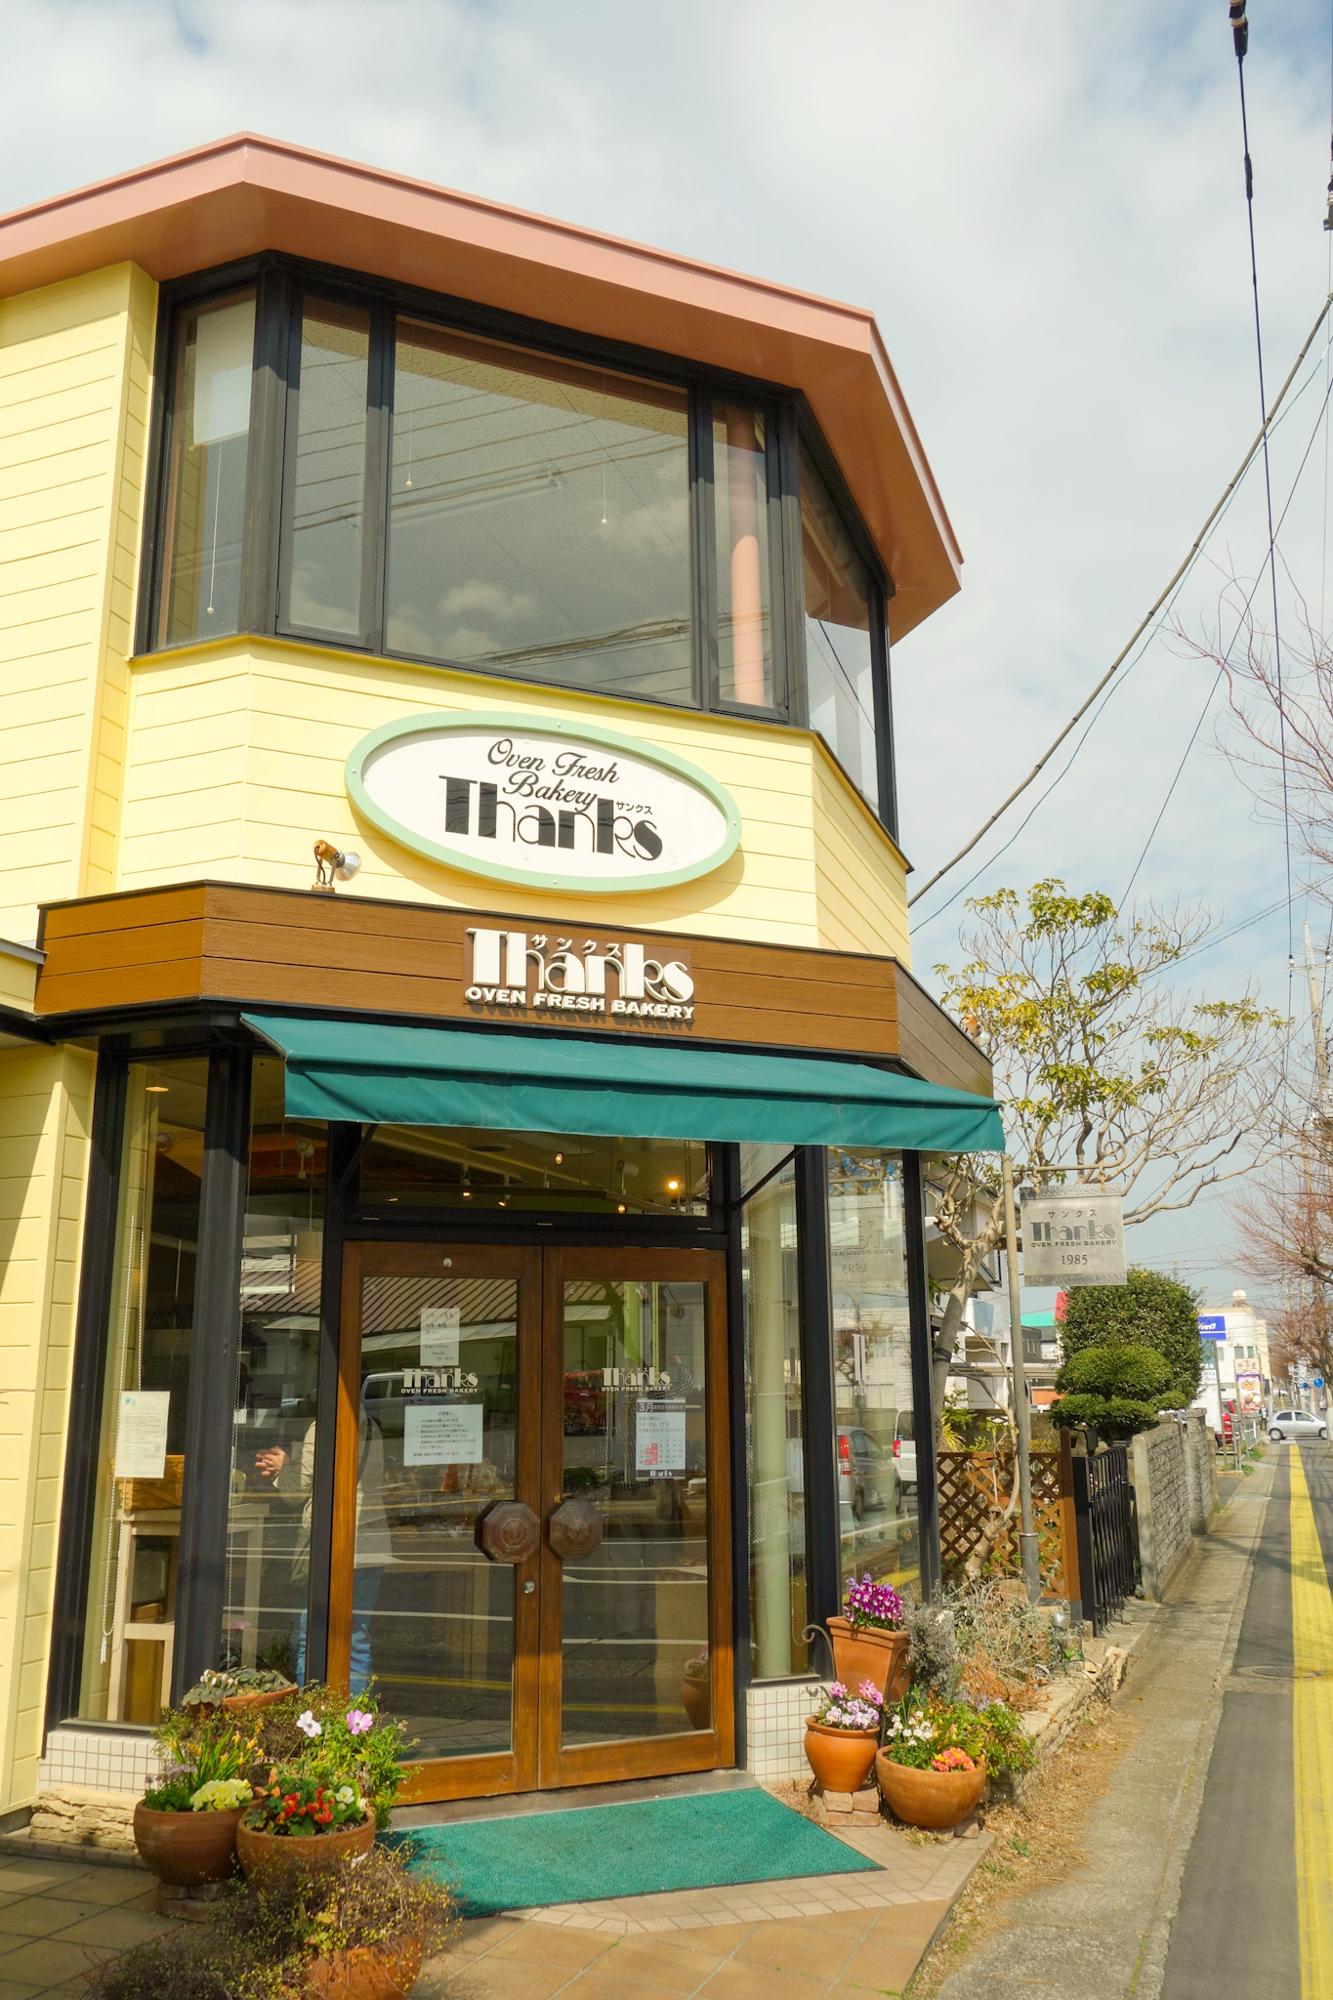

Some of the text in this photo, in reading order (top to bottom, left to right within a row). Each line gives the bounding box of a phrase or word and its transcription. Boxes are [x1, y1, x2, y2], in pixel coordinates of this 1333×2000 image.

[487, 738, 620, 784] Oven Fresh
[502, 770, 597, 814] Bakery
[438, 776, 663, 861] Thanks
[616, 801, 653, 815] サンクス
[531, 934, 622, 957] サンクス
[466, 927, 694, 1003] Thanks
[465, 987, 695, 1020] OVEN FRESH BAKERY
[1048, 1209, 1098, 1219] サンクス
[1030, 1220, 1116, 1241] Thanks
[1061, 1254, 1088, 1266] 1985
[401, 1368, 478, 1388] Thanks
[601, 1366, 671, 1386] Thanks
